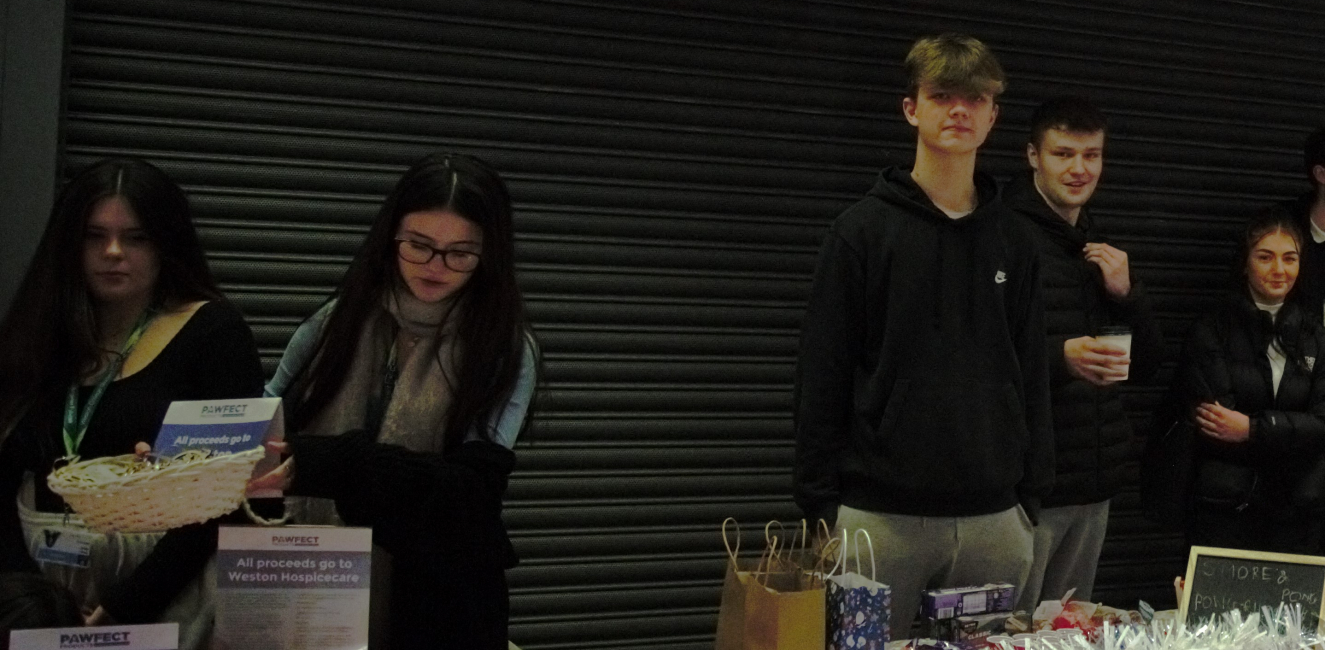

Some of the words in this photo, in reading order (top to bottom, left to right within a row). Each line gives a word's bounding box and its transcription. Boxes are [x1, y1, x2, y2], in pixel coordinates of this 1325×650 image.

[202, 404, 248, 414] PAWFECT
[174, 435, 189, 446] All
[188, 434, 230, 447] proceeds
[230, 435, 242, 446] go
[242, 433, 252, 443] to
[271, 536, 320, 544] PAWFECT
[236, 557, 254, 568] All
[256, 557, 317, 570] proceeds
[318, 560, 337, 571] go
[339, 558, 353, 570] to
[228, 571, 278, 583] Weston
[280, 571, 360, 584] Hospicecare
[59, 631, 131, 644] PAWFECT
